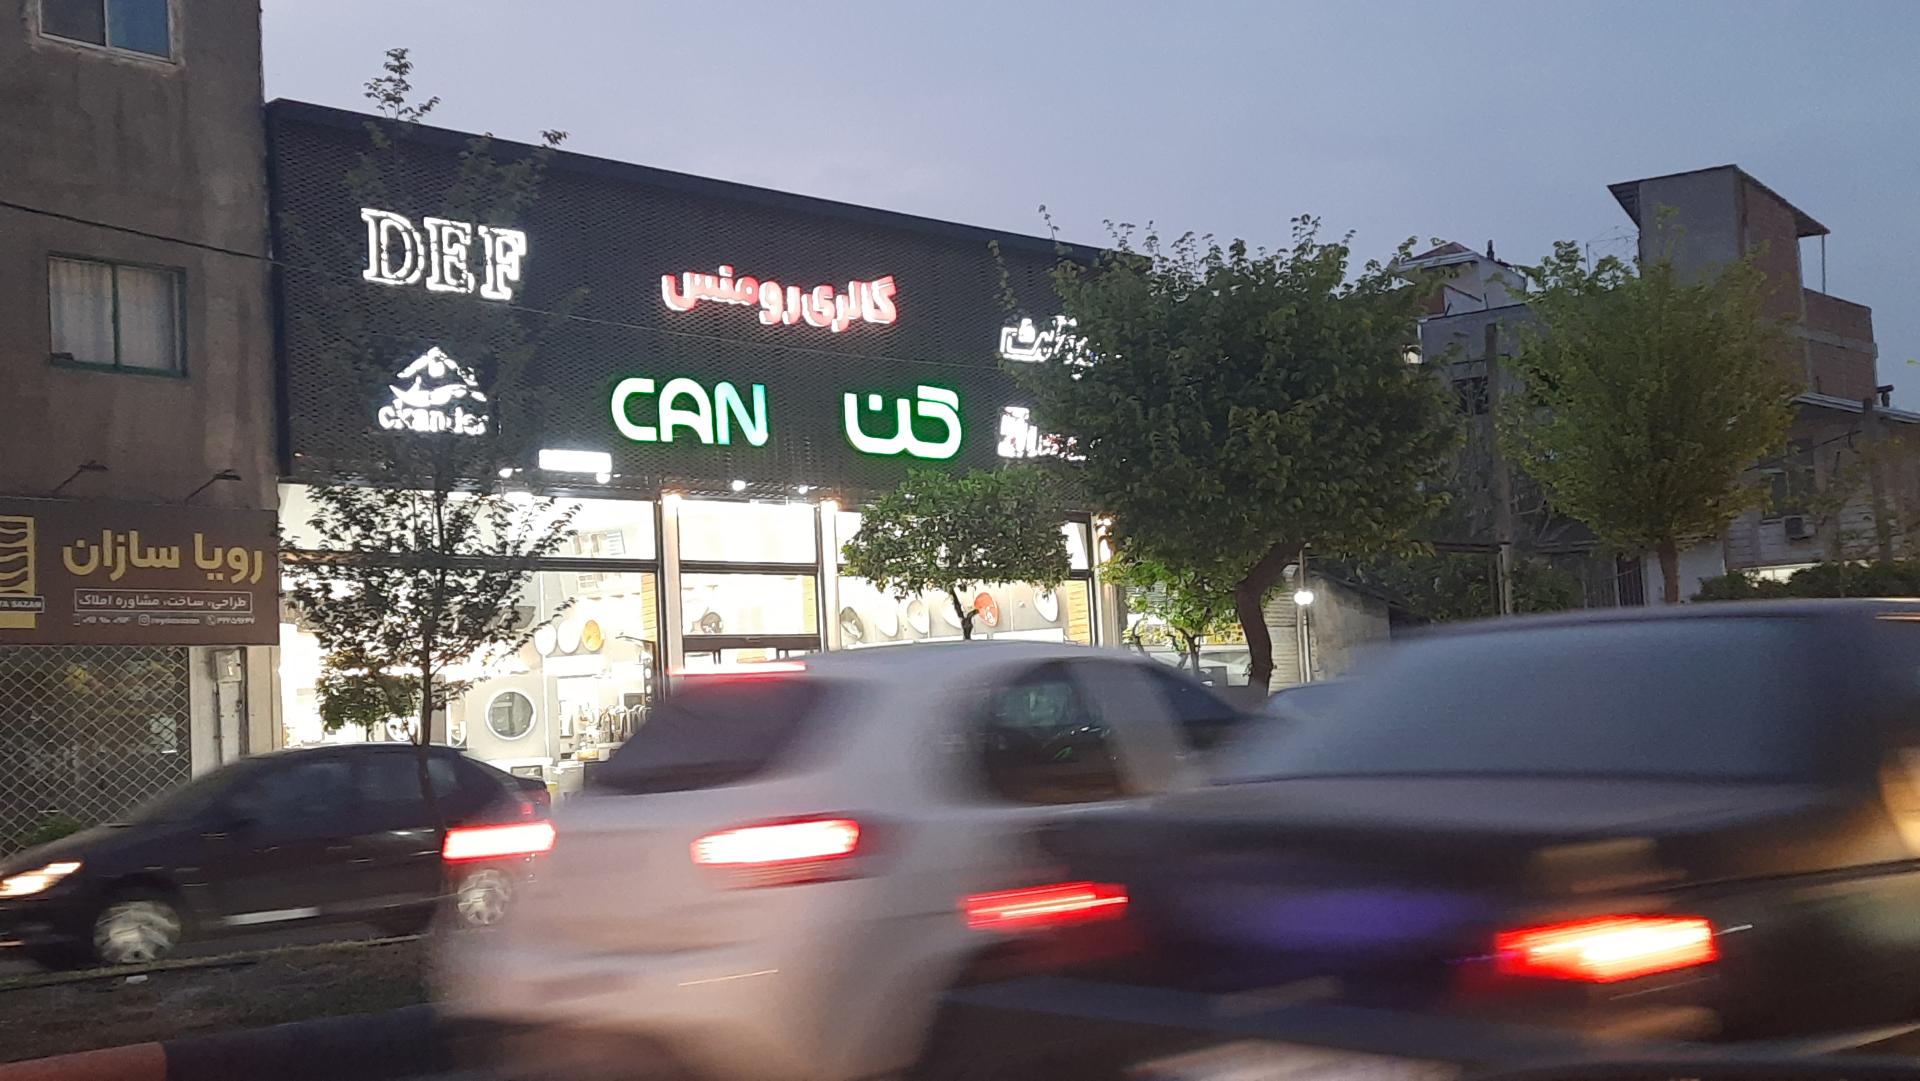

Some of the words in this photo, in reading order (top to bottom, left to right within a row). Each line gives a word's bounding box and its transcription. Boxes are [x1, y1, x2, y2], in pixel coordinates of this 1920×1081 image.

[661, 264, 801, 325] رومنس
[801, 275, 897, 333] گالری
[611, 377, 768, 447] CAN
[62, 528, 181, 582] سازان
[194, 532, 263, 584] رویا
[78, 594, 112, 605] املاک
[115, 594, 160, 609] مشاوره
